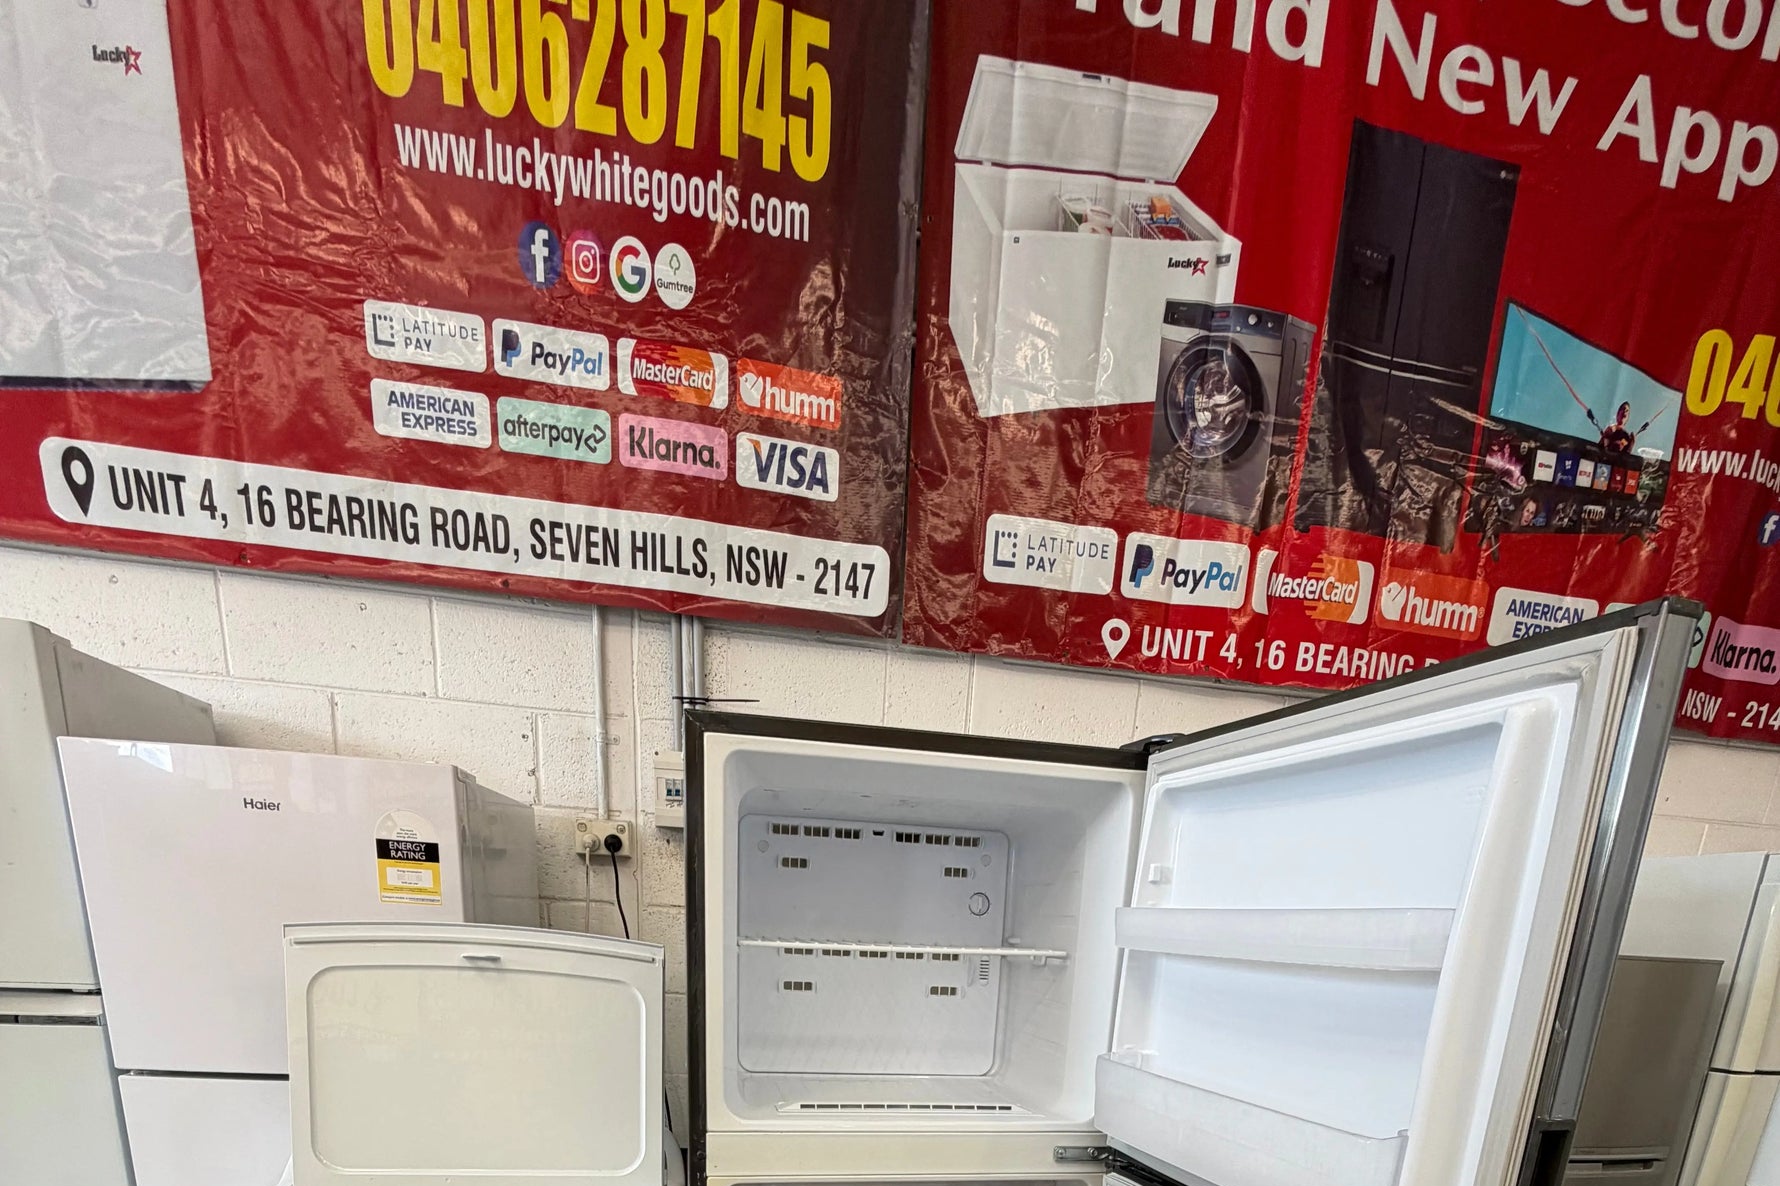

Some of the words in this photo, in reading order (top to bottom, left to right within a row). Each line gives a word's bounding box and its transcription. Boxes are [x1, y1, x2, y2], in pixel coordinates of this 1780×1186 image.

[92, 44, 130, 68] Lucky
[364, 0, 831, 182] 0406287145
[1366, 0, 1578, 136] New
[1595, 74, 1779, 202] App
[394, 123, 810, 242] www.luckywhitegoods.com
[1168, 257, 1199, 270] Lucky
[656, 277, 694, 295] Gumtree
[402, 316, 479, 341] LATITUDE
[404, 337, 432, 353] PAY
[531, 340, 603, 376] PayPal
[632, 358, 715, 392] MasterCard
[387, 390, 475, 417] AMERICAN
[765, 381, 835, 423] humm
[401, 411, 478, 437] EXPRESS
[503, 414, 584, 451] afterpay
[629, 425, 721, 469] Klarna.
[747, 438, 830, 494] VISA
[107, 464, 186, 517] UNIT
[199, 478, 229, 530] 4,
[237, 482, 276, 528] 16
[284, 488, 420, 546] BEARING
[430, 505, 520, 564] ROAD,
[529, 517, 620, 568] SEVEN
[631, 530, 716, 586] HILLS,
[726, 543, 788, 589] NSW
[814, 557, 876, 600] 2147
[1027, 534, 1110, 560] LATITUDE
[1026, 554, 1057, 573] PAY
[1161, 557, 1243, 594] PayPal
[1268, 572, 1359, 605] MasterCard
[1506, 599, 1584, 624] AMERICAN
[1141, 625, 1214, 661] UNIT
[1219, 633, 1243, 669] 4,
[1254, 638, 1286, 671] 16
[1296, 642, 1414, 680] BEARING
[1710, 628, 1777, 674] Klarna.
[1681, 688, 1722, 724] NSW
[243, 797, 281, 812] Haier
[388, 841, 426, 851] ENERGY
[390, 850, 426, 860] RATING
